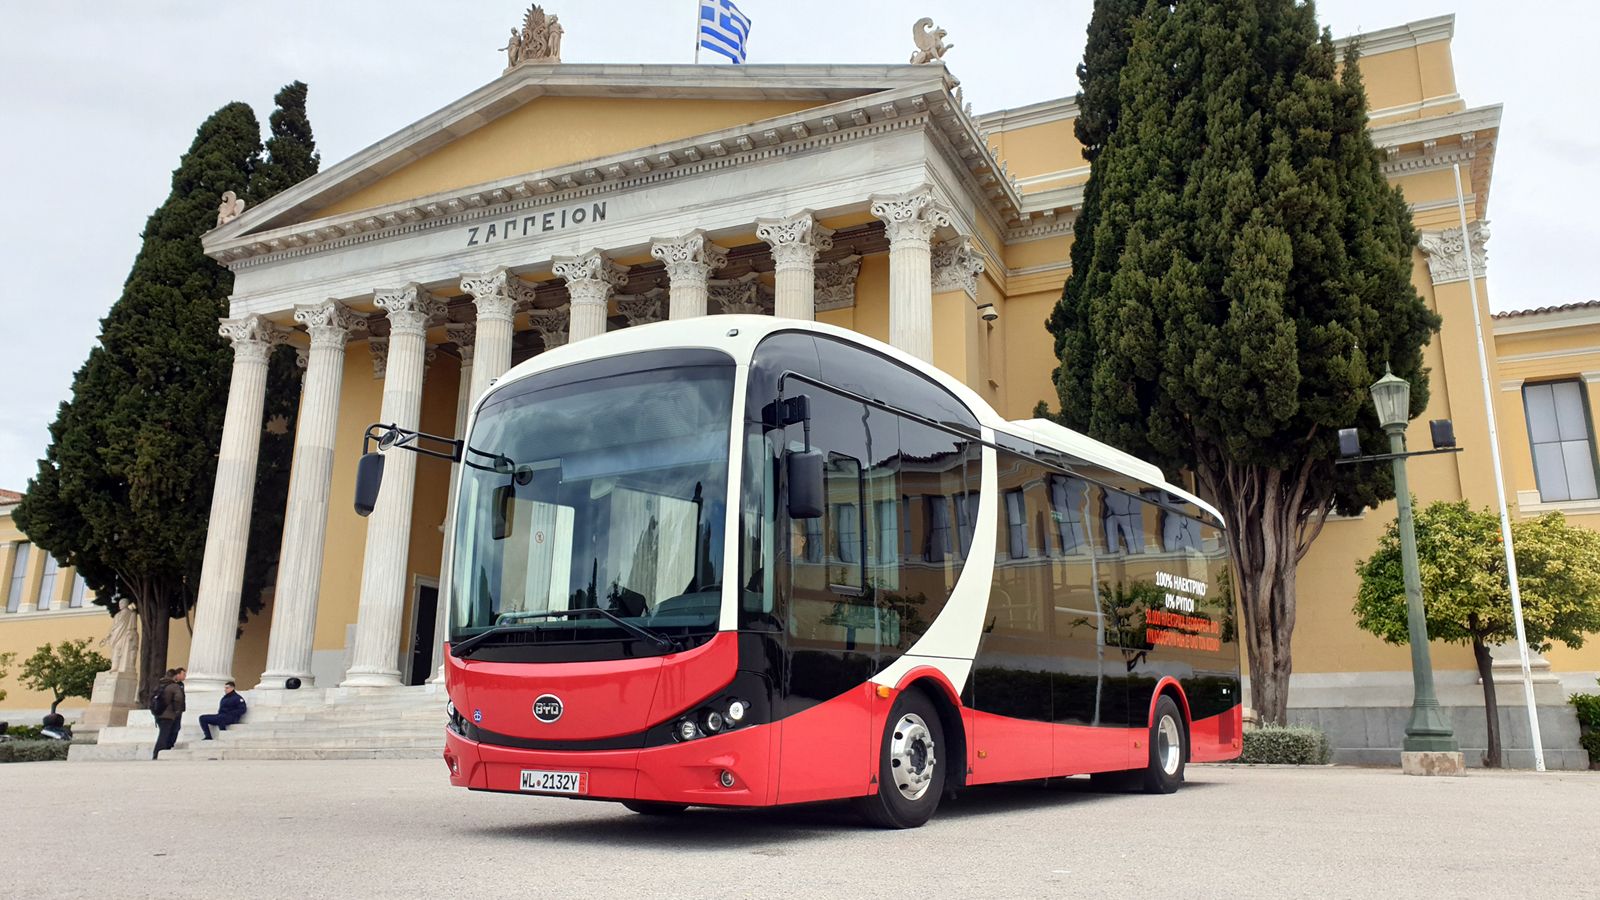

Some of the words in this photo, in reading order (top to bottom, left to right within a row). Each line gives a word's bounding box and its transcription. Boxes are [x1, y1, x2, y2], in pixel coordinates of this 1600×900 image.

[1155, 571, 1173, 588] 100%
[1165, 593, 1176, 609] 0%
[536, 702, 559, 715] BYD
[522, 772, 535, 788] WL
[542, 773, 578, 790] 2132Y
